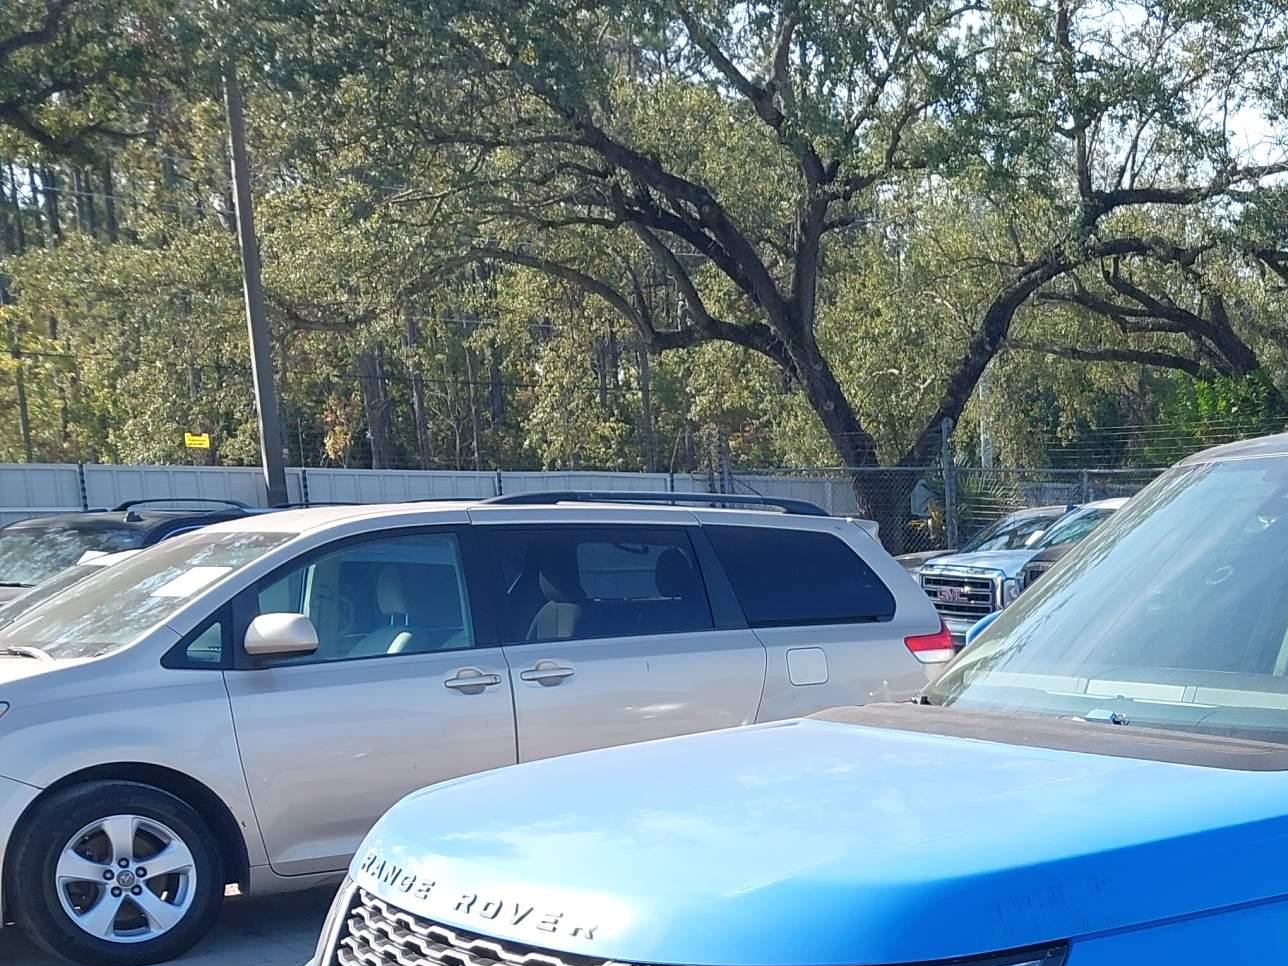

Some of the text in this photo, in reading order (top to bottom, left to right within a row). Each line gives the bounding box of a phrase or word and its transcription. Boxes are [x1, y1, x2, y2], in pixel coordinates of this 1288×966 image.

[936, 586, 968, 603] GMC
[360, 852, 600, 940] RANGE ROVER
